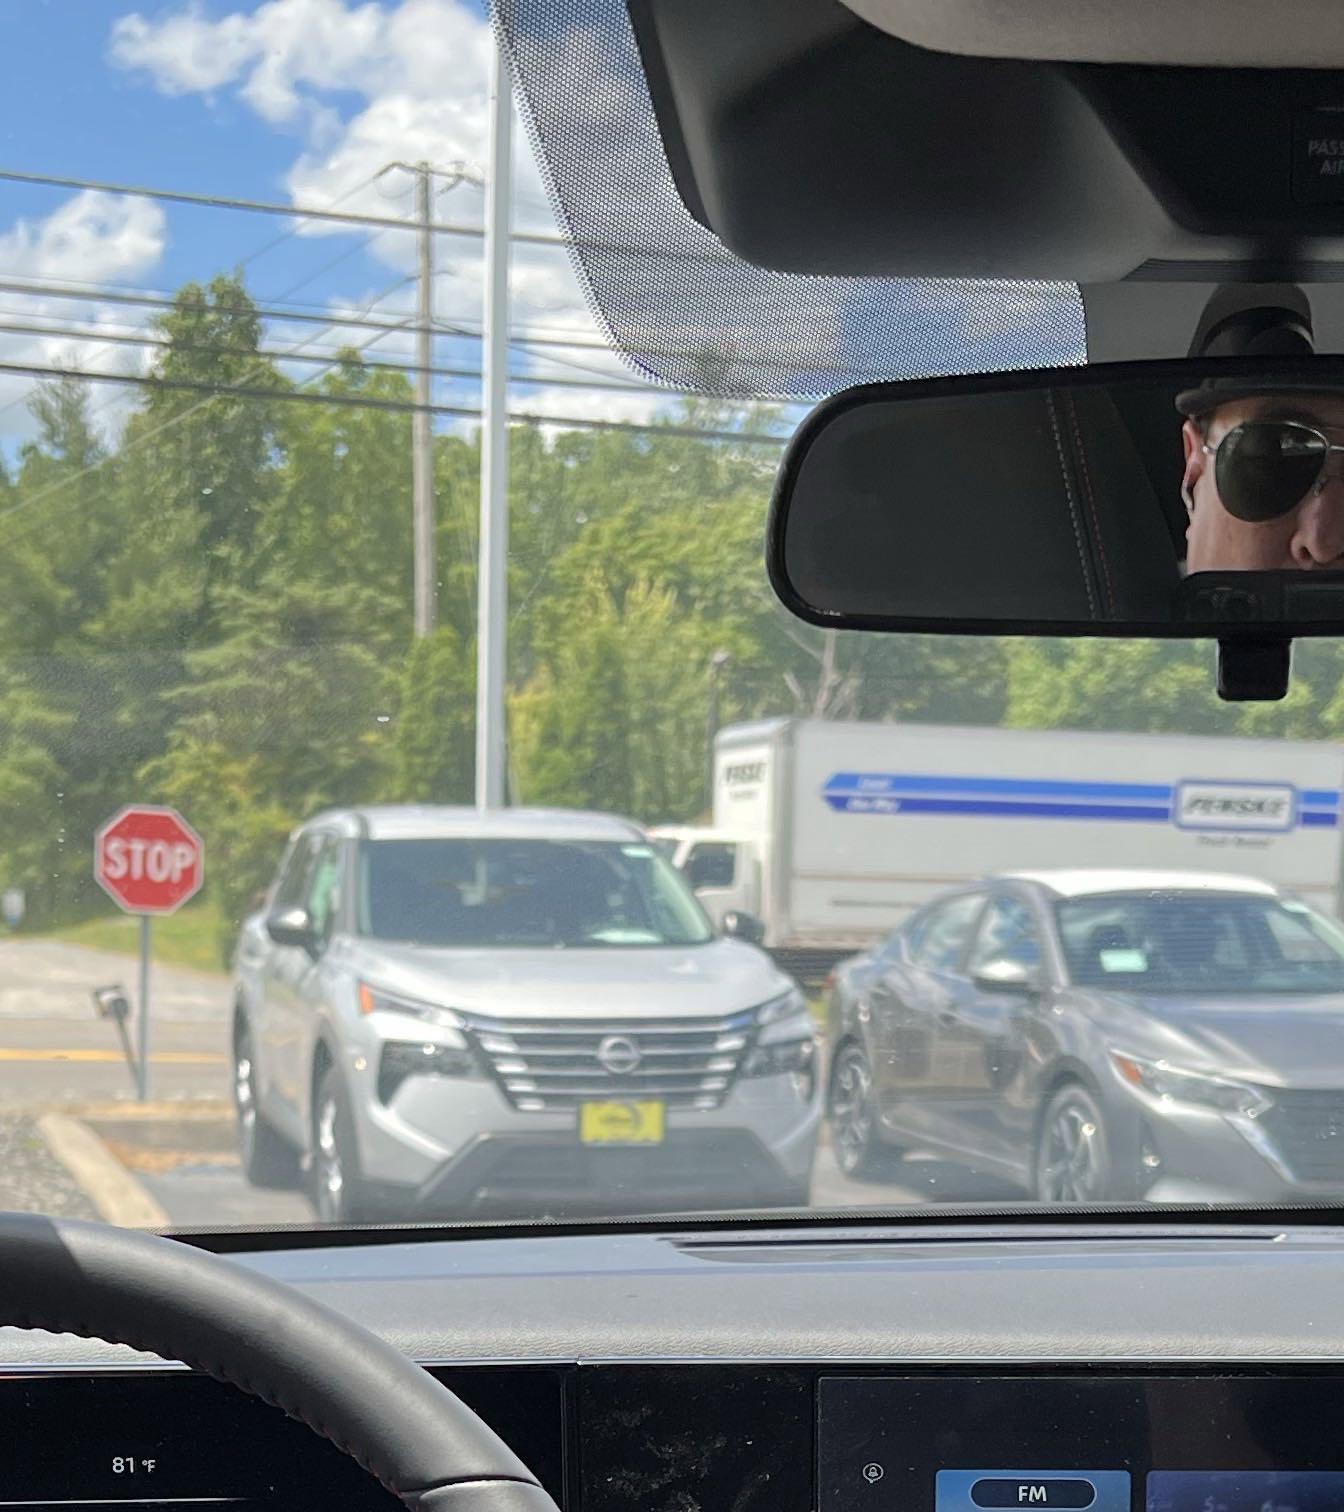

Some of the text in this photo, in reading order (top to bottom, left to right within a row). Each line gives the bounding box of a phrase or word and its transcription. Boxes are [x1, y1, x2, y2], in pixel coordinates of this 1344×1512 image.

[105, 836, 193, 884] STOP
[112, 1457, 135, 1474] 81
[1018, 1486, 1047, 1502] FM
